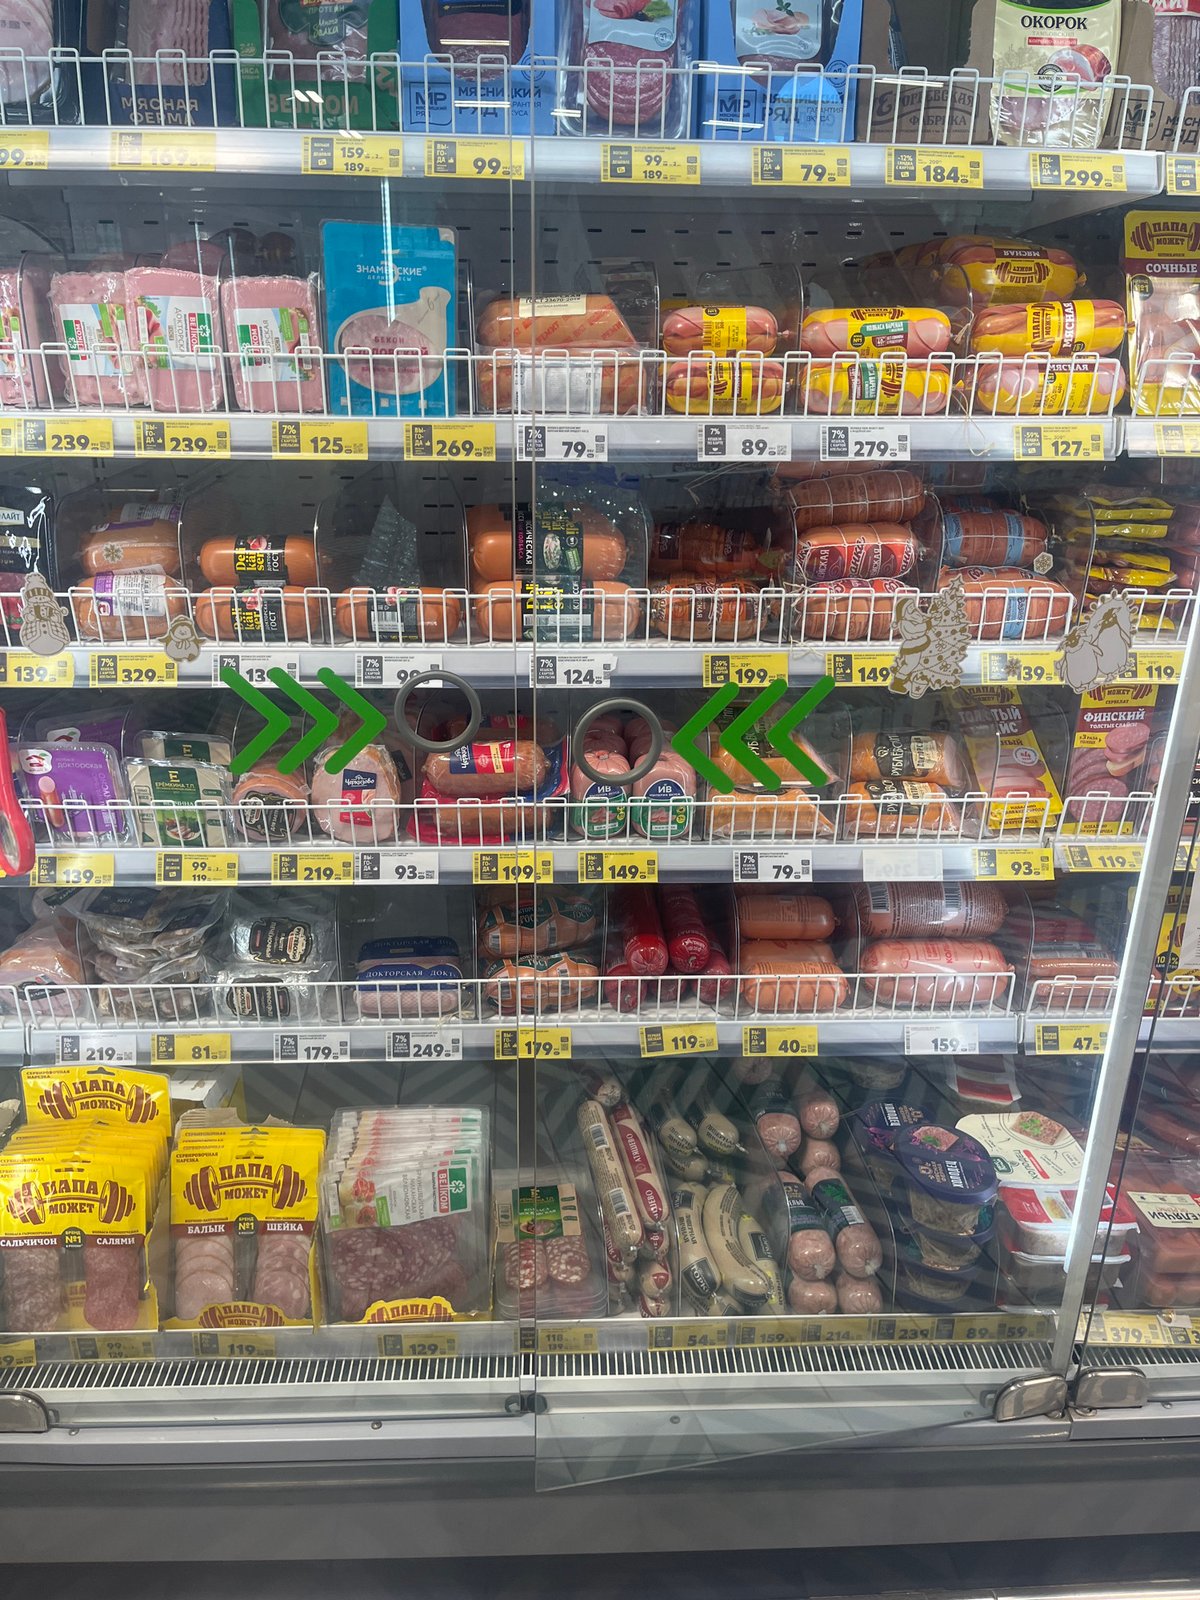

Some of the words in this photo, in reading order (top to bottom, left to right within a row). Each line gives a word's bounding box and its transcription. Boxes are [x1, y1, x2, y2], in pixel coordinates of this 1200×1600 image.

[1020, 15, 1088, 30] ОКОРОК
[341, 147, 364, 159] 159
[436, 156, 446, 164] ДА
[473, 157, 501, 175] 99
[645, 155, 662, 166] 99
[344, 162, 364, 172] 189
[763, 164, 772, 172] ДА
[800, 165, 827, 182] 79
[1042, 168, 1051, 176] ДА
[643, 170, 662, 180] 189
[923, 165, 960, 183] 184
[1064, 169, 1103, 186] 299
[1153, 221, 1188, 232] ПАПА
[1156, 237, 1185, 246] МОЖЕТ
[1146, 263, 1198, 273] СОЧНЫЕ
[1009, 274, 1034, 284] ПАПА
[1032, 309, 1041, 340] ПАПА
[1062, 302, 1078, 348] МЯСНАЯ
[281, 425, 296, 435] 7%
[832, 430, 845, 439] 7%
[51, 434, 89, 451] 239
[170, 437, 207, 452] 239
[310, 437, 343, 454] 125
[436, 440, 474, 457] 269
[742, 439, 768, 456] 89
[854, 441, 889, 457] 279
[1051, 440, 1082, 457] 127
[562, 441, 587, 458] 79
[235, 547, 246, 571] Deli
[272, 553, 280, 572] ГОСТ
[270, 611, 278, 631] ГОСТ
[100, 658, 114, 667] 7%
[223, 659, 236, 667] 7%
[366, 659, 379, 668] 7%
[540, 660, 553, 668] 7%
[13, 667, 47, 683] 139
[122, 668, 157, 682] 329
[564, 669, 595, 684] 124
[735, 669, 769, 683] 199
[858, 668, 891, 682] 149
[1145, 665, 1175, 680] 119
[1107, 688, 1130, 696] МОЖЕТ
[1083, 708, 1146, 722] ФИНСКИЙ
[598, 786, 612, 794] ИВ
[658, 784, 672, 793] ИВ
[743, 855, 756, 864] 7%
[1099, 855, 1127, 868] 119
[192, 862, 207, 871] 99
[394, 865, 418, 880] 93
[609, 865, 639, 880] 149
[773, 865, 794, 879] 79
[1011, 862, 1033, 876] 93
[63, 869, 94, 883] 139
[192, 874, 207, 882] 119
[304, 867, 334, 880] 219
[502, 866, 534, 881] 199
[366, 970, 423, 978] ДОКТОРСКАЯ
[283, 1037, 295, 1045] 7%
[671, 1035, 698, 1050] 119
[778, 1039, 800, 1053] 40
[931, 1038, 960, 1052] 159
[1073, 1038, 1093, 1050] 47
[86, 1047, 116, 1060] 219
[192, 1046, 211, 1059] 81
[304, 1047, 332, 1060] 179
[413, 1044, 444, 1057] 249
[524, 1041, 553, 1055] 179
[72, 1079, 126, 1097] ПАПА
[80, 1100, 123, 1112] МОЖЕТ
[219, 1163, 272, 1181] ПАПА
[42, 1179, 99, 1195] ПАПА
[224, 1188, 268, 1200] МОЖЕТ
[49, 1203, 95, 1214] МОЖЕТ
[187, 1225, 225, 1234] БАЛЫК
[238, 1222, 254, 1230] №1
[266, 1222, 304, 1232] ШЕЙКА
[0, 1238, 57, 1247] САЛЬЧИЧОН
[65, 1235, 82, 1244] №1
[96, 1237, 135, 1246] САЛЯМИ
[223, 1304, 260, 1316] ПАПА
[391, 1304, 429, 1317] ПАПА
[227, 1318, 258, 1327] МОЖЕТ
[760, 1333, 785, 1344] 159
[825, 1331, 850, 1341] 214
[898, 1328, 929, 1339] 239
[966, 1327, 989, 1339] 89
[1006, 1326, 1028, 1338] 59
[1110, 1327, 1143, 1342] 379
[107, 1343, 122, 1351] 99
[687, 1335, 709, 1347] 54
[108, 1351, 124, 1359] 129
[227, 1344, 257, 1356] 119
[409, 1343, 439, 1356] 129
